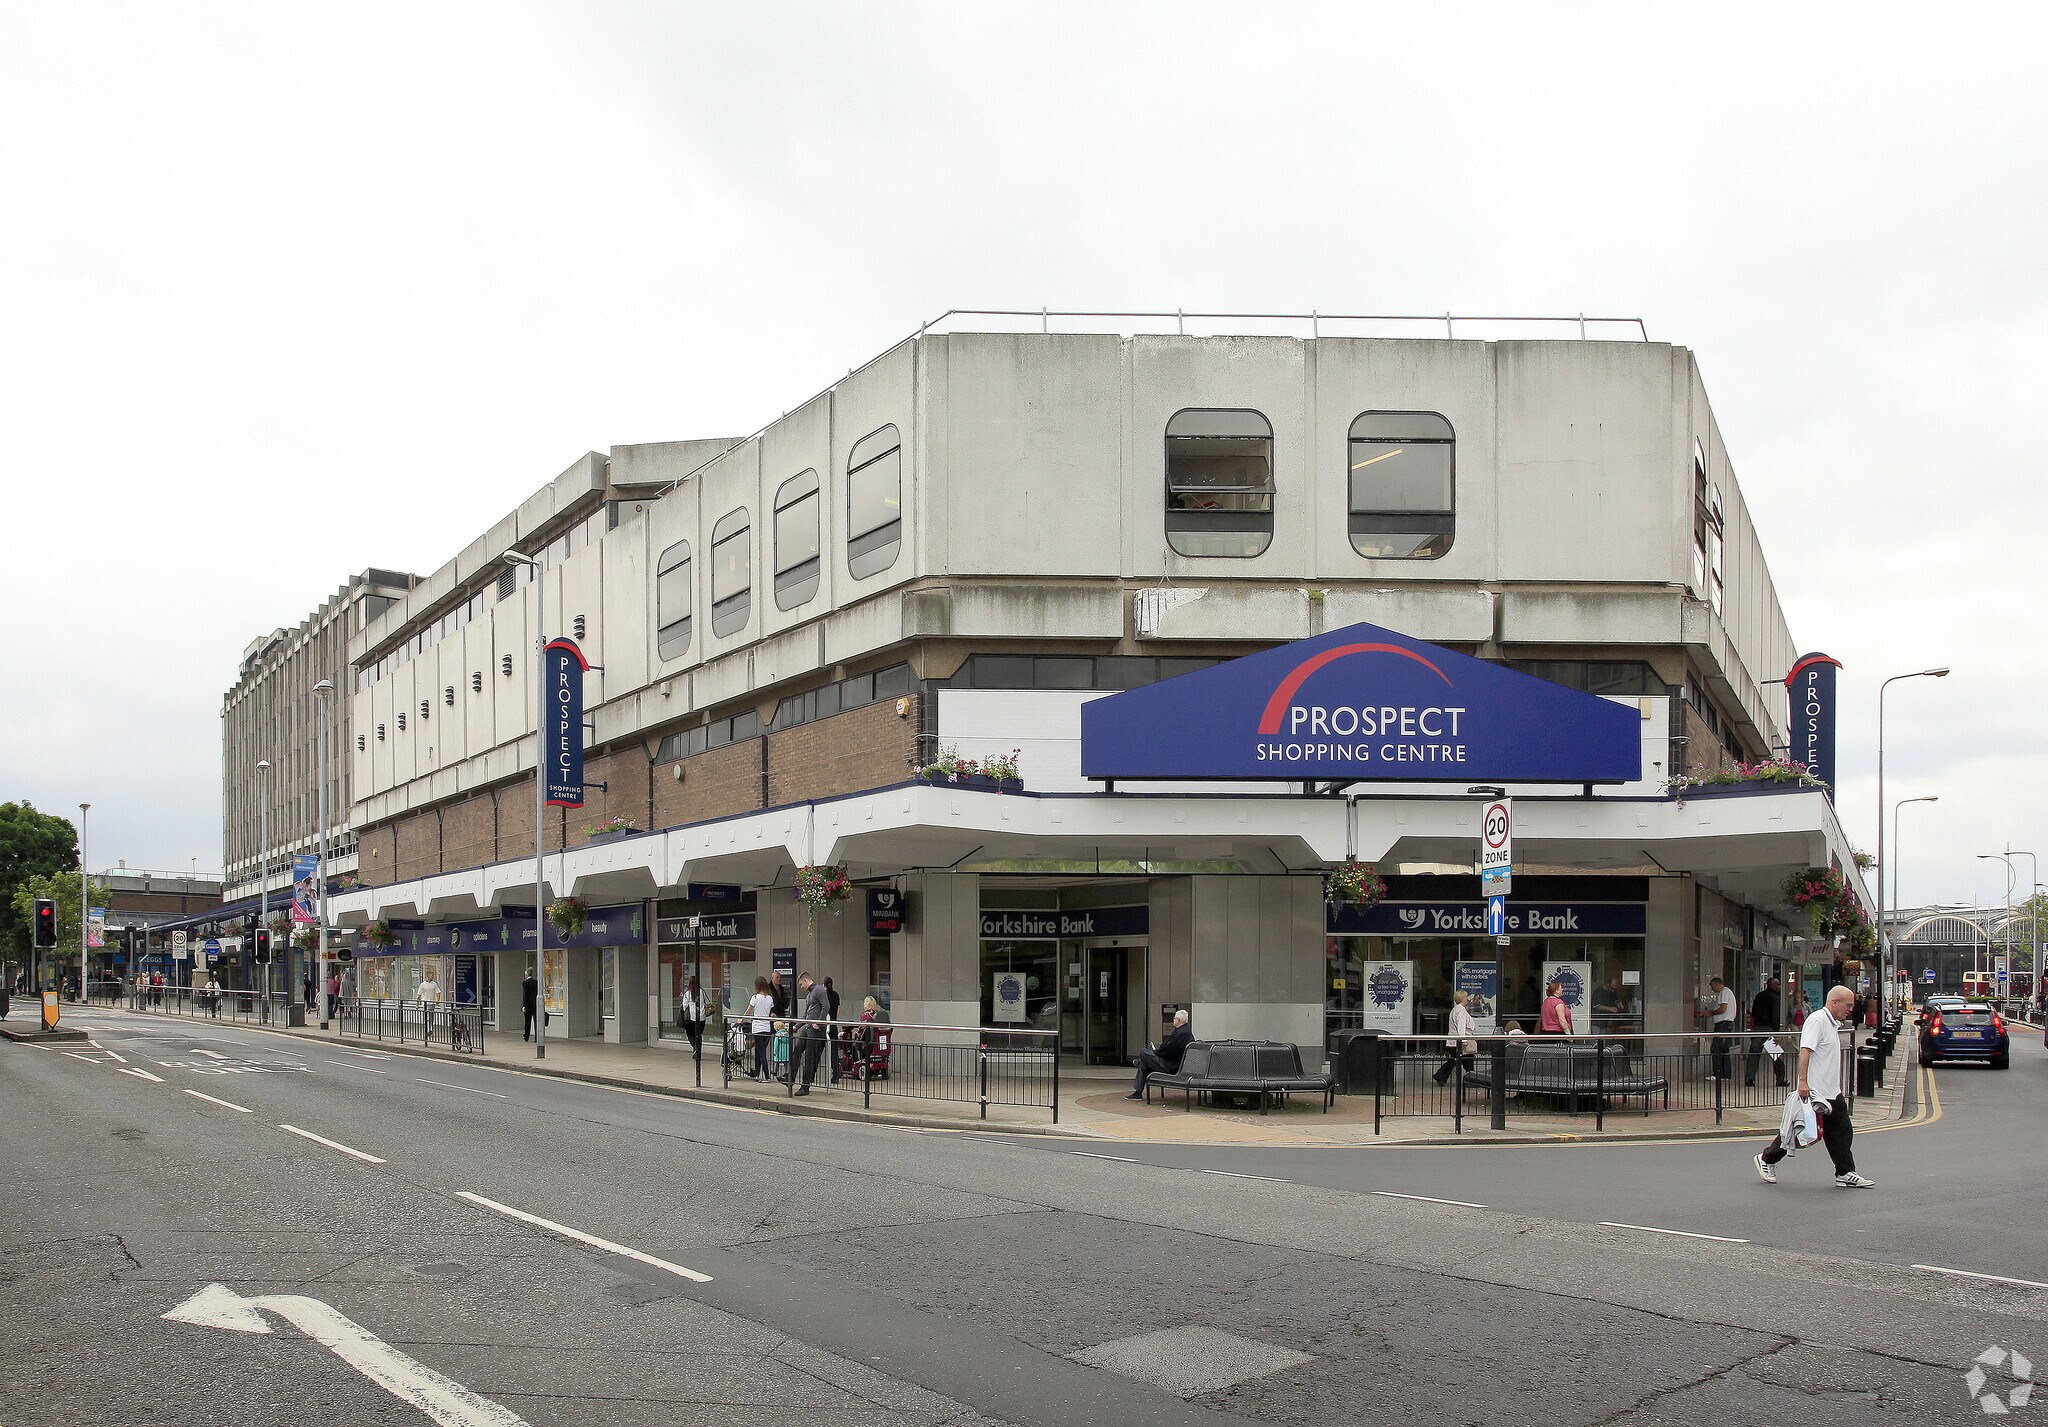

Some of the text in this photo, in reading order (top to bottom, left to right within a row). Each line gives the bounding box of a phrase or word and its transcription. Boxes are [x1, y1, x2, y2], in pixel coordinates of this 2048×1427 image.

[558, 656, 571, 783] PROSPECT
[1291, 706, 1466, 737] PROSPECT
[1805, 671, 1820, 778] PROSPEC
[1256, 743, 1466, 763] SHOPPING CENTRE
[549, 784, 581, 794] SHOPPING
[553, 791, 577, 800] CENTRE
[1488, 816, 1506, 836] 20
[1485, 850, 1508, 864] ZONE
[591, 922, 608, 934] beauty
[716, 918, 738, 937] Bank
[1061, 912, 1095, 934] Bank
[1430, 907, 1579, 930] Yorkshre Bank
